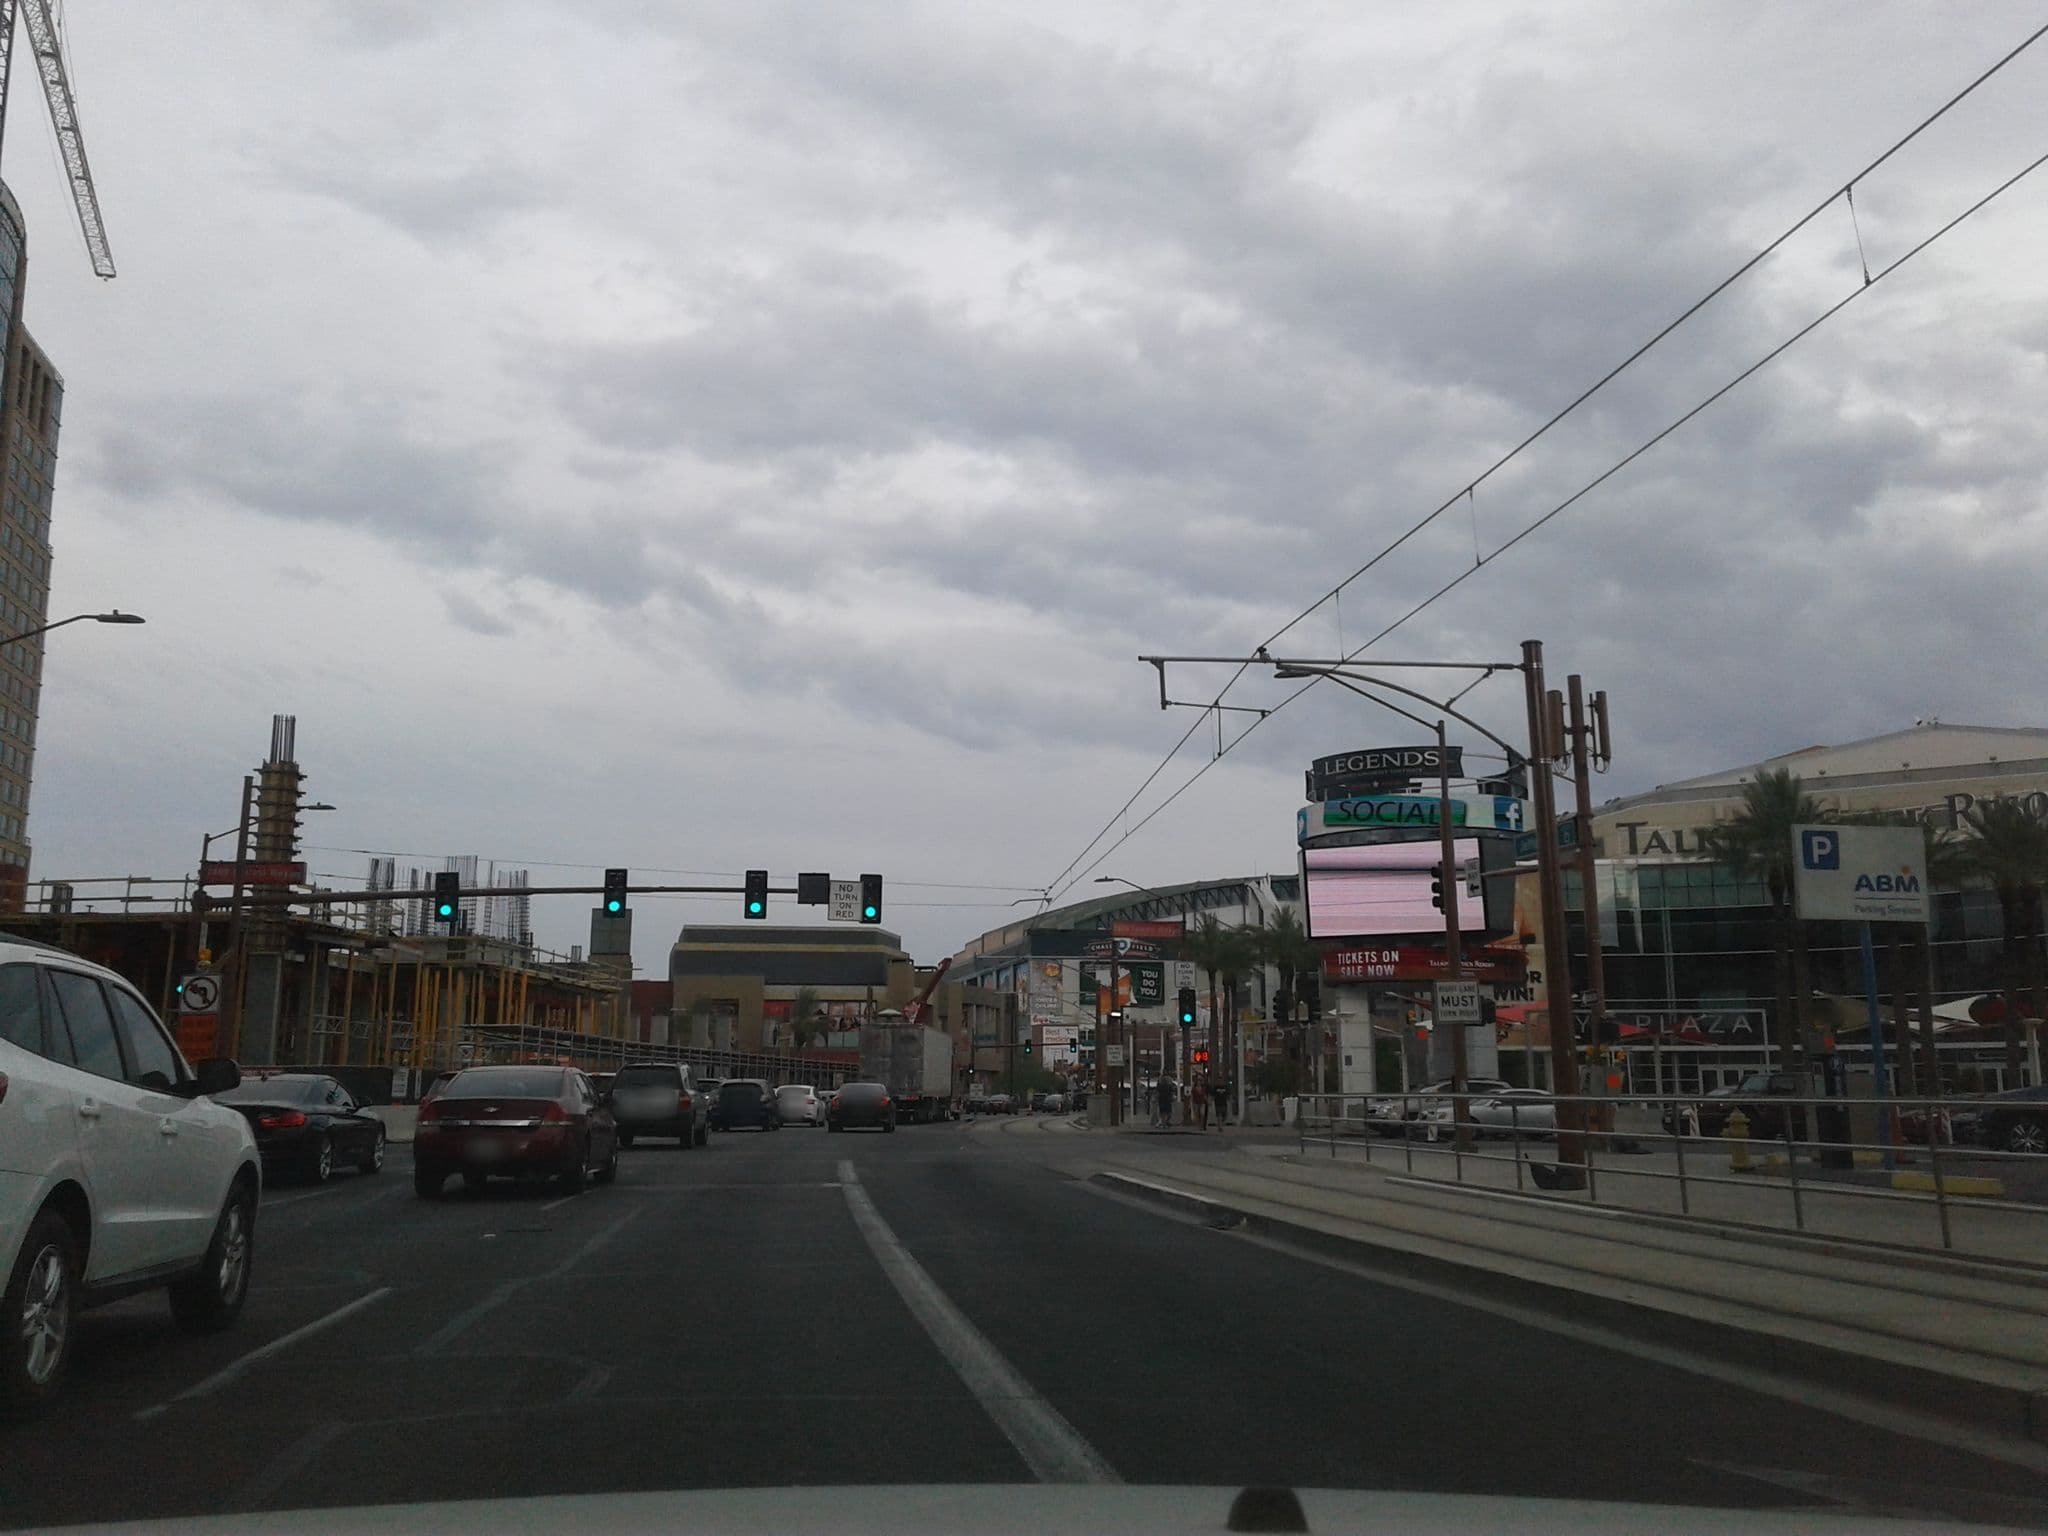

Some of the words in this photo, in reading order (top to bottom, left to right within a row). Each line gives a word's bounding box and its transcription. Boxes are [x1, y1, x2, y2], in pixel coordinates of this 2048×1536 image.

[1324, 751, 1440, 775] LEGENDS
[1339, 801, 1440, 825] SOCIAL
[1811, 835, 1832, 864] P
[839, 884, 853, 892] NO
[1855, 874, 1920, 892] ABM
[834, 893, 858, 902] TURN
[835, 910, 854, 918] RED
[1338, 951, 1377, 965] TICKETS
[1382, 951, 1400, 963] ON
[1142, 970, 1158, 978] YOU
[1341, 967, 1363, 977] SALE
[1367, 965, 1395, 976] NOW
[1143, 979, 1155, 987] DO
[1140, 987, 1156, 996] YOU
[1494, 986, 1534, 1001] WIN!
[1440, 995, 1475, 1007] MUST
[1636, 1015, 1753, 1034] PLAZA
